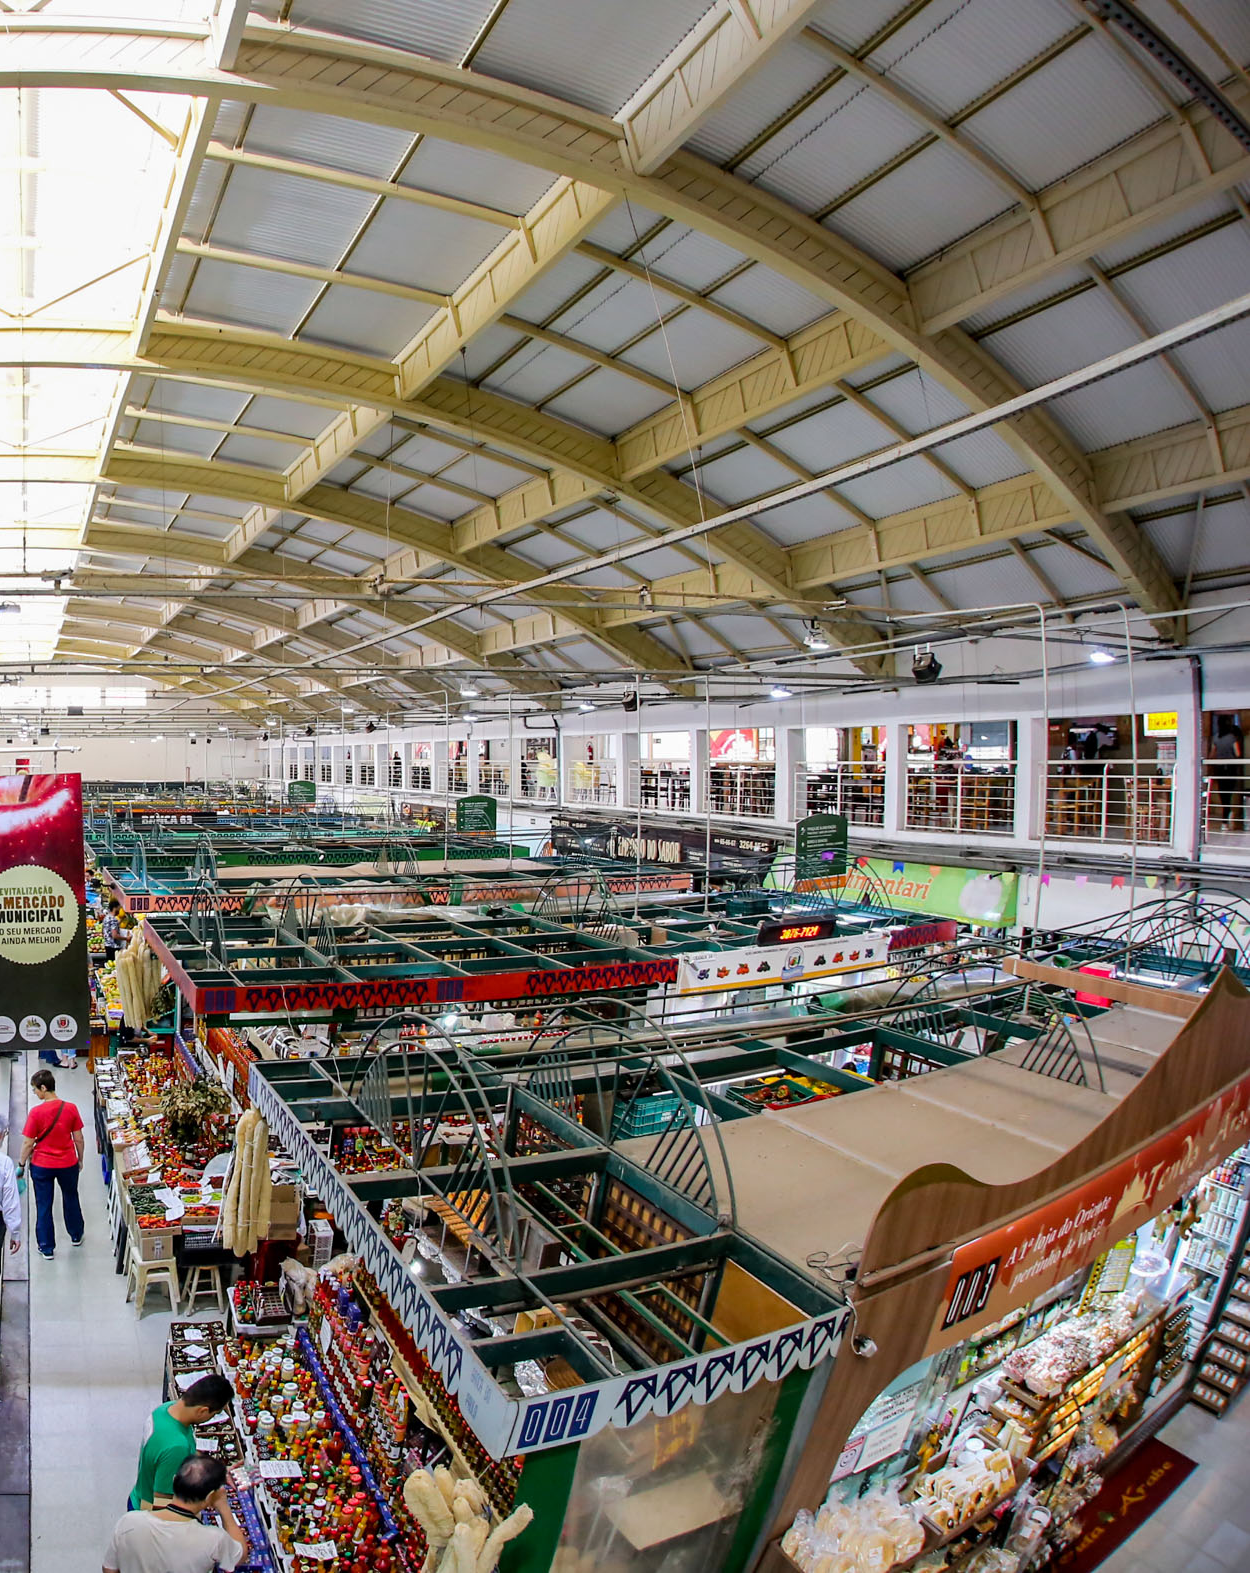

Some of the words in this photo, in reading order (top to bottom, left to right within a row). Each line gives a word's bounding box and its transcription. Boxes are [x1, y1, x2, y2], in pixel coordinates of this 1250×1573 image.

[3, 895, 65, 909] MERCADO
[1, 937, 27, 945] AINDA
[28, 936, 61, 944] MELHOR
[23, 926, 62, 935] MERCADO
[1004, 1247, 1018, 1268] A
[1033, 1224, 1056, 1255] loja
[1057, 1218, 1073, 1239] do
[1073, 1196, 1113, 1228] Oriente
[1009, 1245, 1062, 1294] pertinho
[1061, 1239, 1076, 1258] de
[946, 1263, 996, 1323] 003
[524, 1398, 591, 1442] 004
